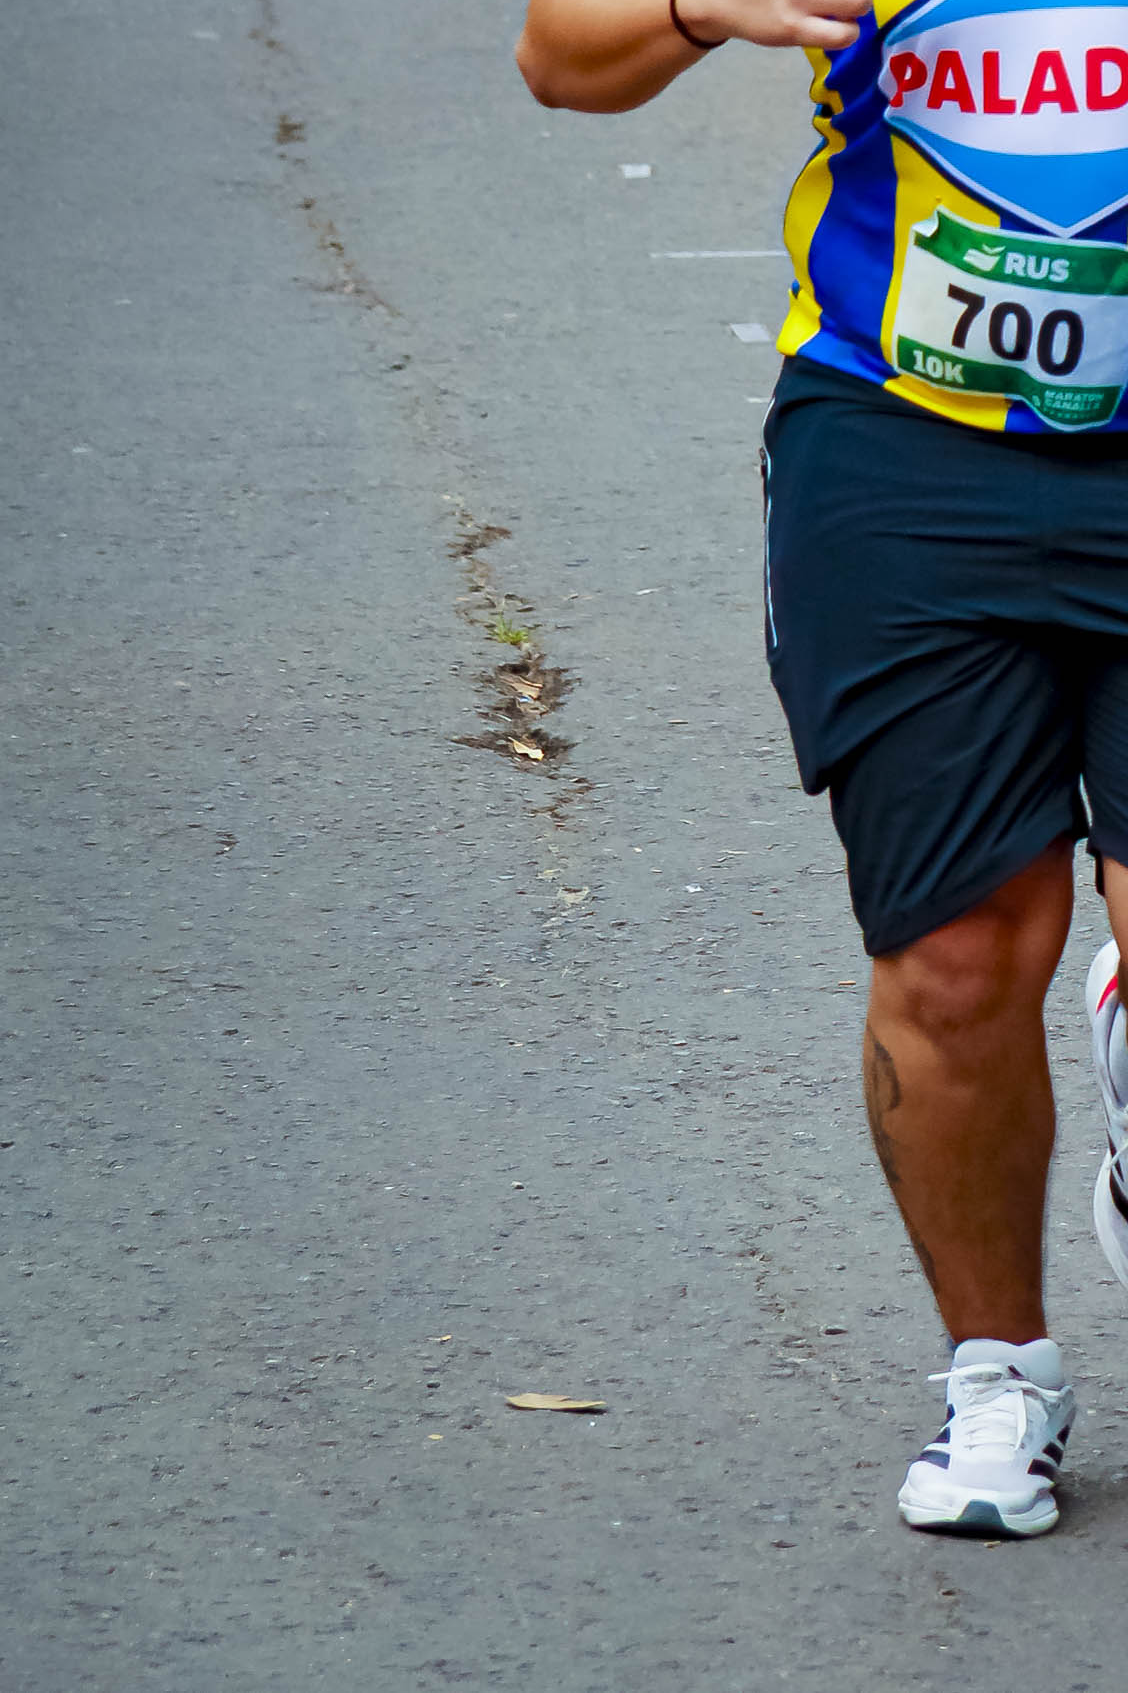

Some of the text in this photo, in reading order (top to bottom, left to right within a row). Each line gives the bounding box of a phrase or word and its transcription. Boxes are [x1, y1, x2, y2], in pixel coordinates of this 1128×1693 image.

[1004, 252, 1070, 283] RUS
[947, 283, 1084, 376] 700
[913, 350, 965, 385] 10K
